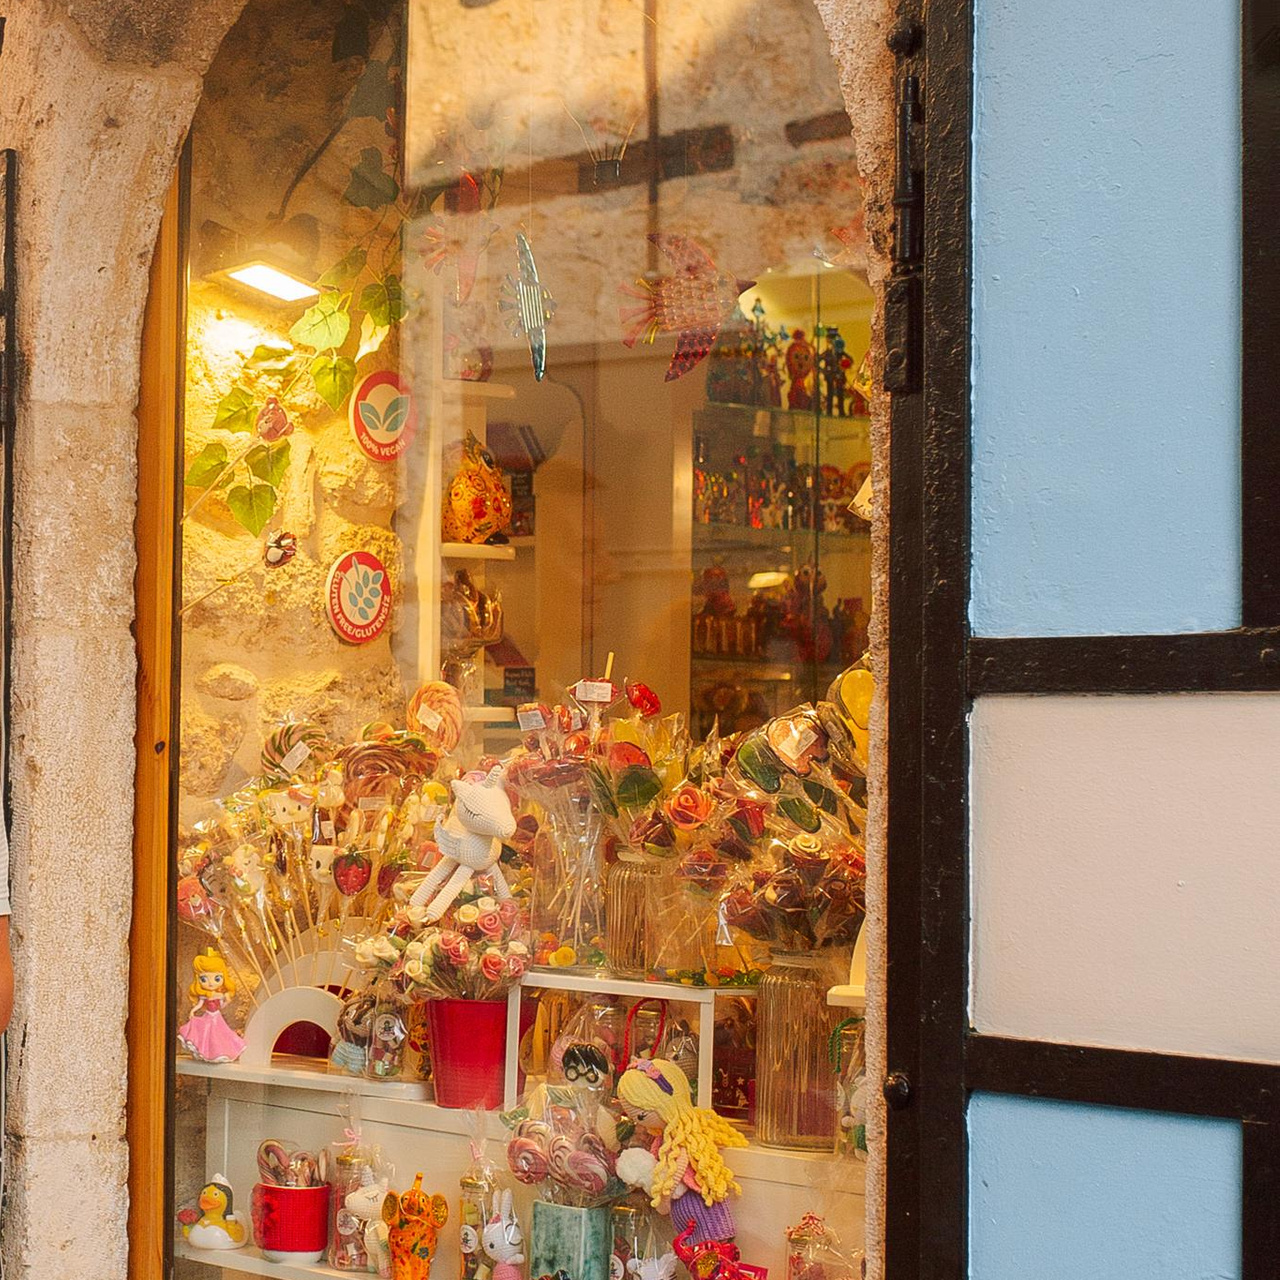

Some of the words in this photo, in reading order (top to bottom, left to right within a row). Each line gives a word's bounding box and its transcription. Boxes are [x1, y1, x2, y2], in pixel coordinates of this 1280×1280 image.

[360, 431, 379, 455] 100%
[380, 438, 406, 457] VEGAN
[331, 571, 341, 614] GLUTEN
